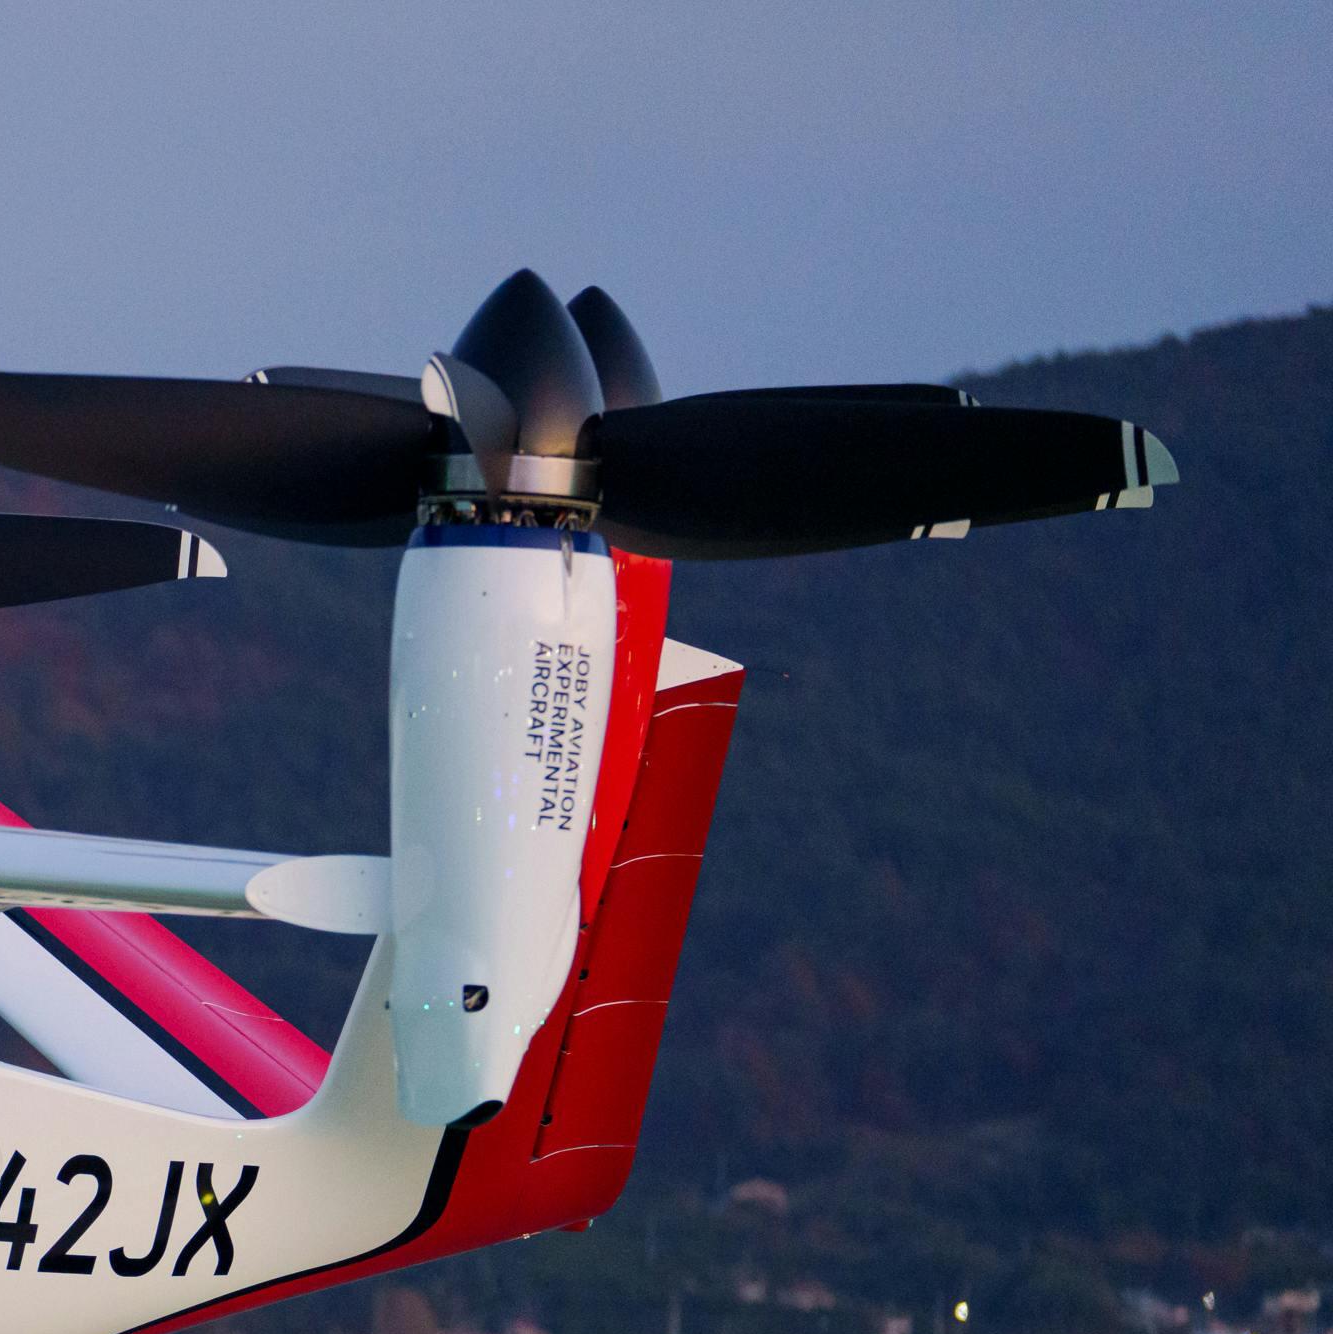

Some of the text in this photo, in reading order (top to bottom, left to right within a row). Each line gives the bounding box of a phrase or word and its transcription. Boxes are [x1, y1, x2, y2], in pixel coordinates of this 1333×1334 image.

[524, 642, 553, 762] AIRCRAFT
[538, 644, 573, 825] EXPERIMENTAL
[558, 645, 591, 831] JOBY AVIATION
